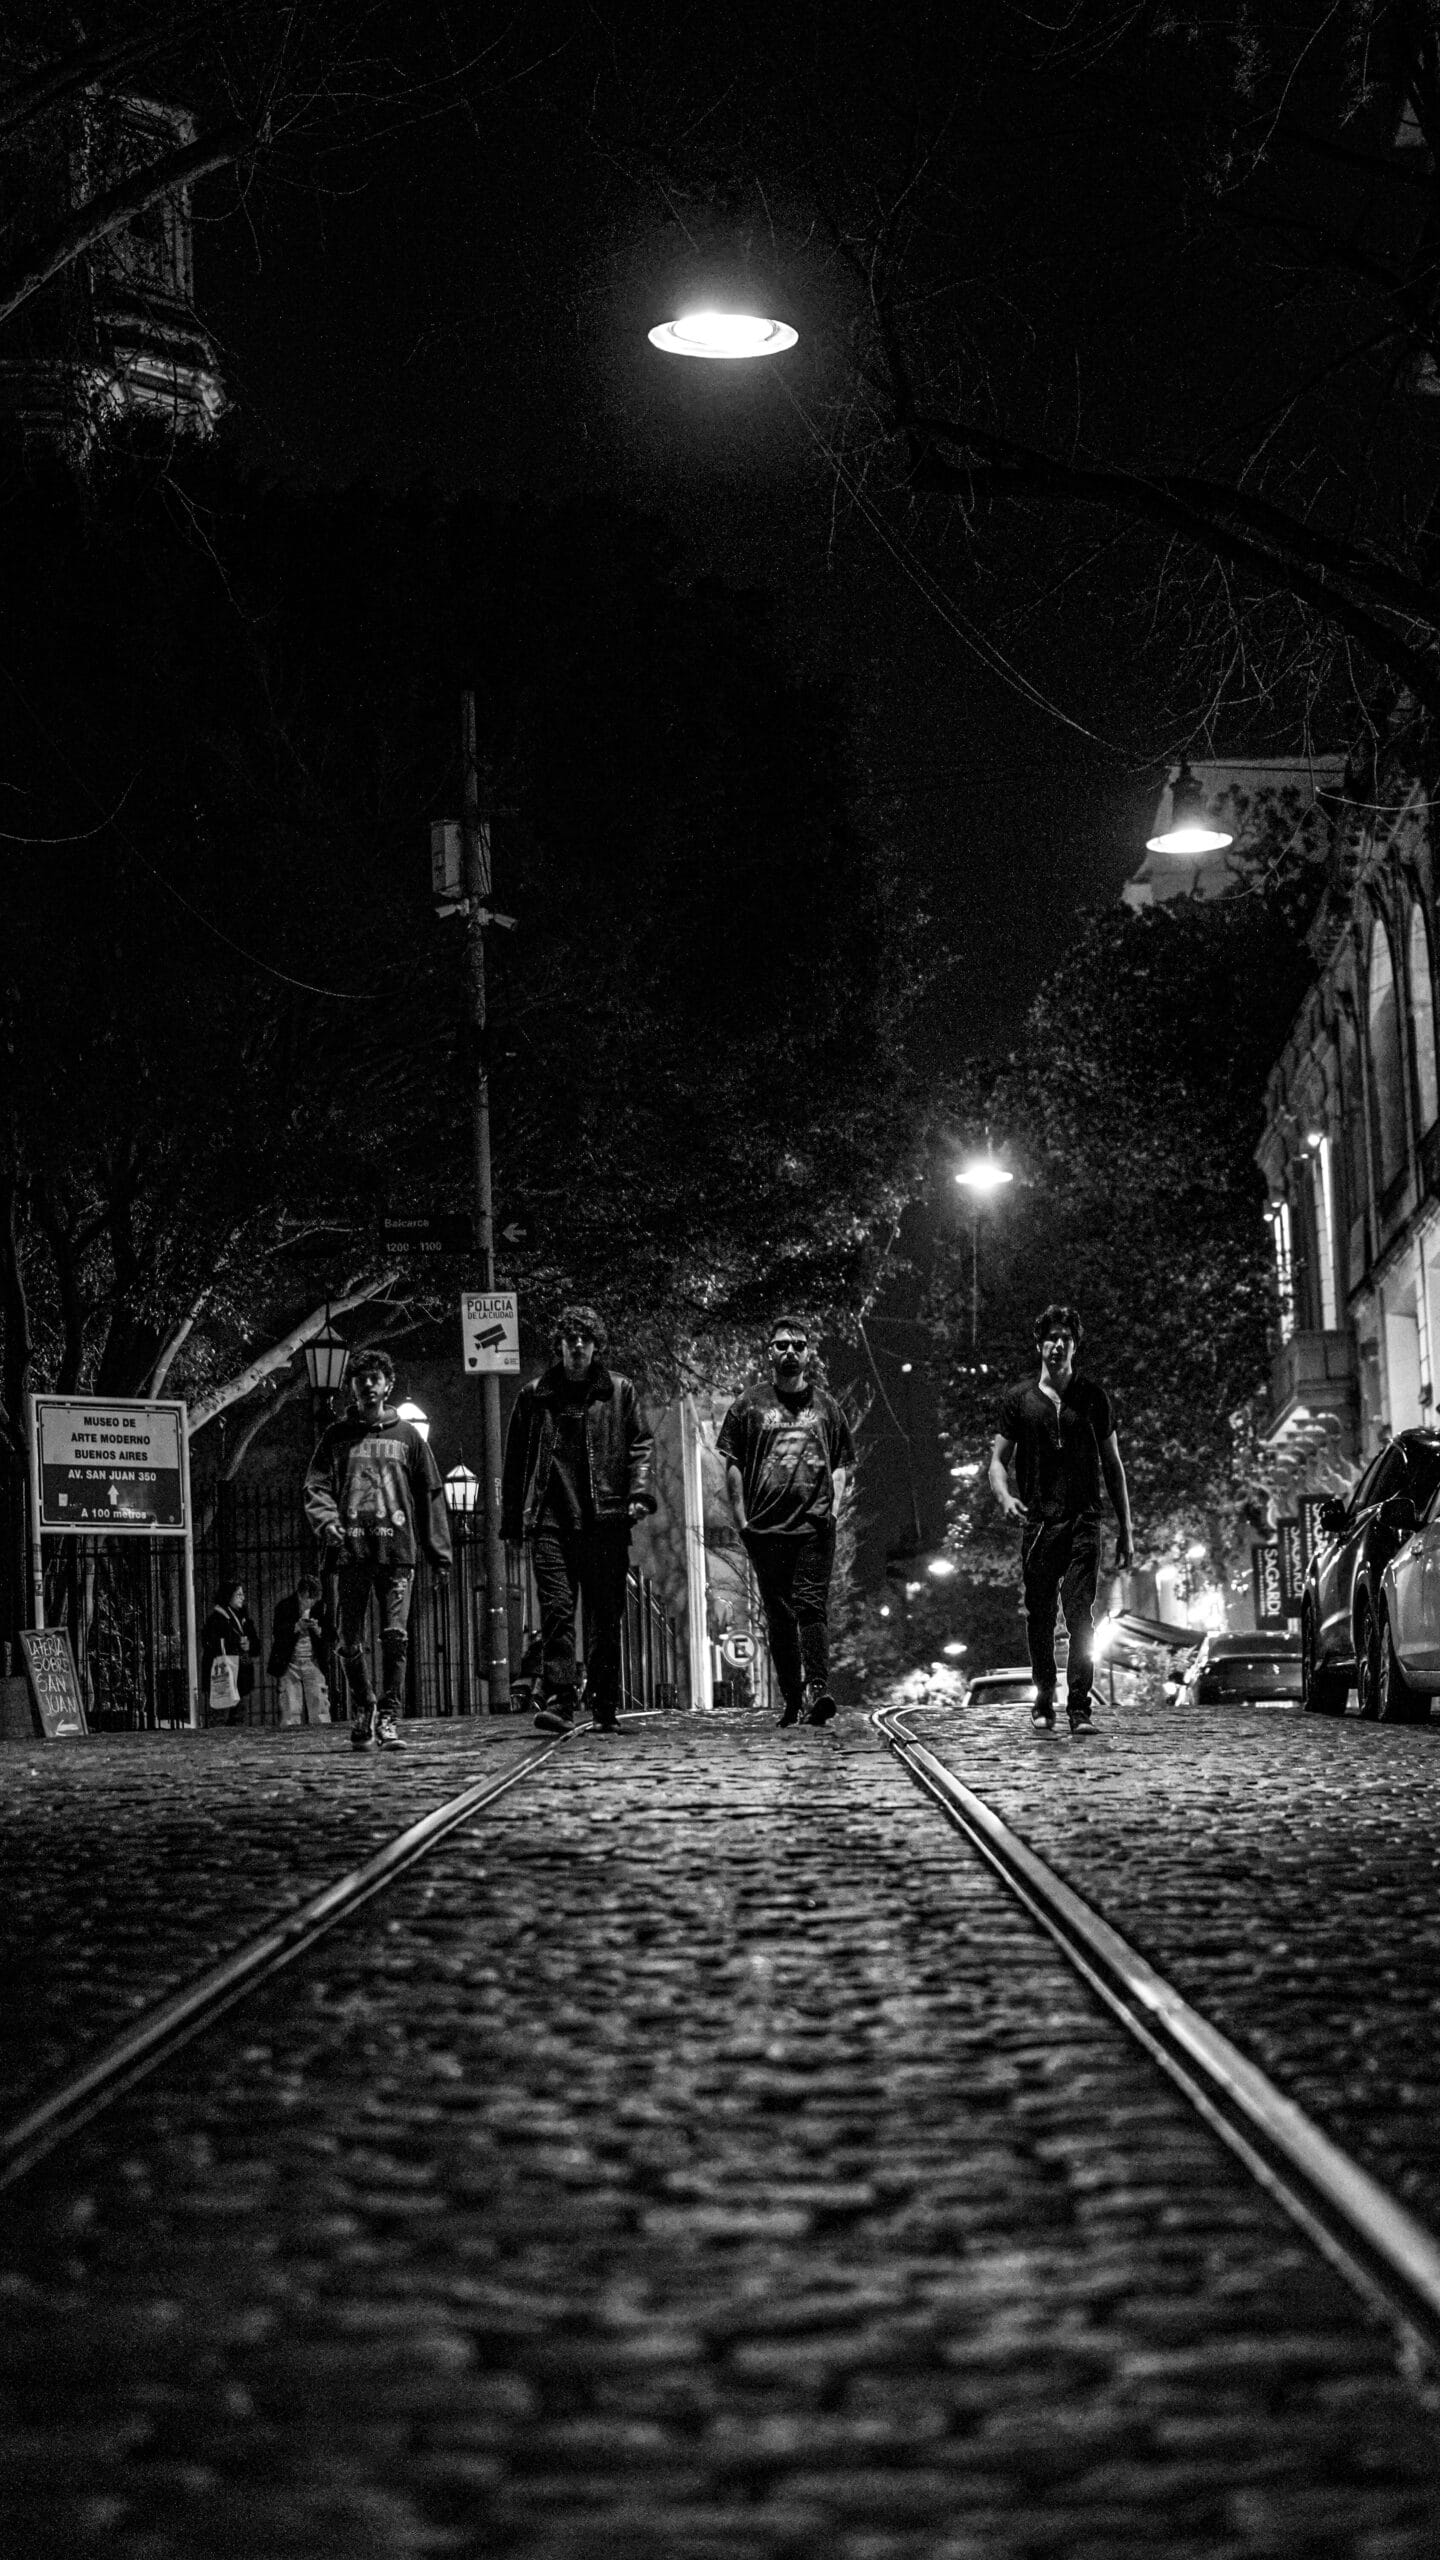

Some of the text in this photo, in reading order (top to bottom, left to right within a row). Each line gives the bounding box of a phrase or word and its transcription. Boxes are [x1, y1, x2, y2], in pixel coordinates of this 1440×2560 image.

[384, 1218, 430, 1228] Balcarce
[386, 1242, 410, 1251] 1200
[419, 1241, 442, 1250] 1100
[467, 1299, 513, 1312] POLICIA
[488, 1311, 514, 1319] CIUDAD
[83, 1417, 136, 1427] MUSEO DE
[71, 1432, 150, 1444] ARTE MODERNO
[74, 1449, 148, 1461] BUENOS AIRES
[68, 1469, 156, 1481] AV. SAN JUAN 350
[81, 1508, 147, 1519] A 100 metros
[1264, 1548, 1281, 1616] SAGARDI
[32, 1656, 70, 1673] SOBRE
[37, 1673, 67, 1693] SAN
[44, 1695, 77, 1716] JUAN
